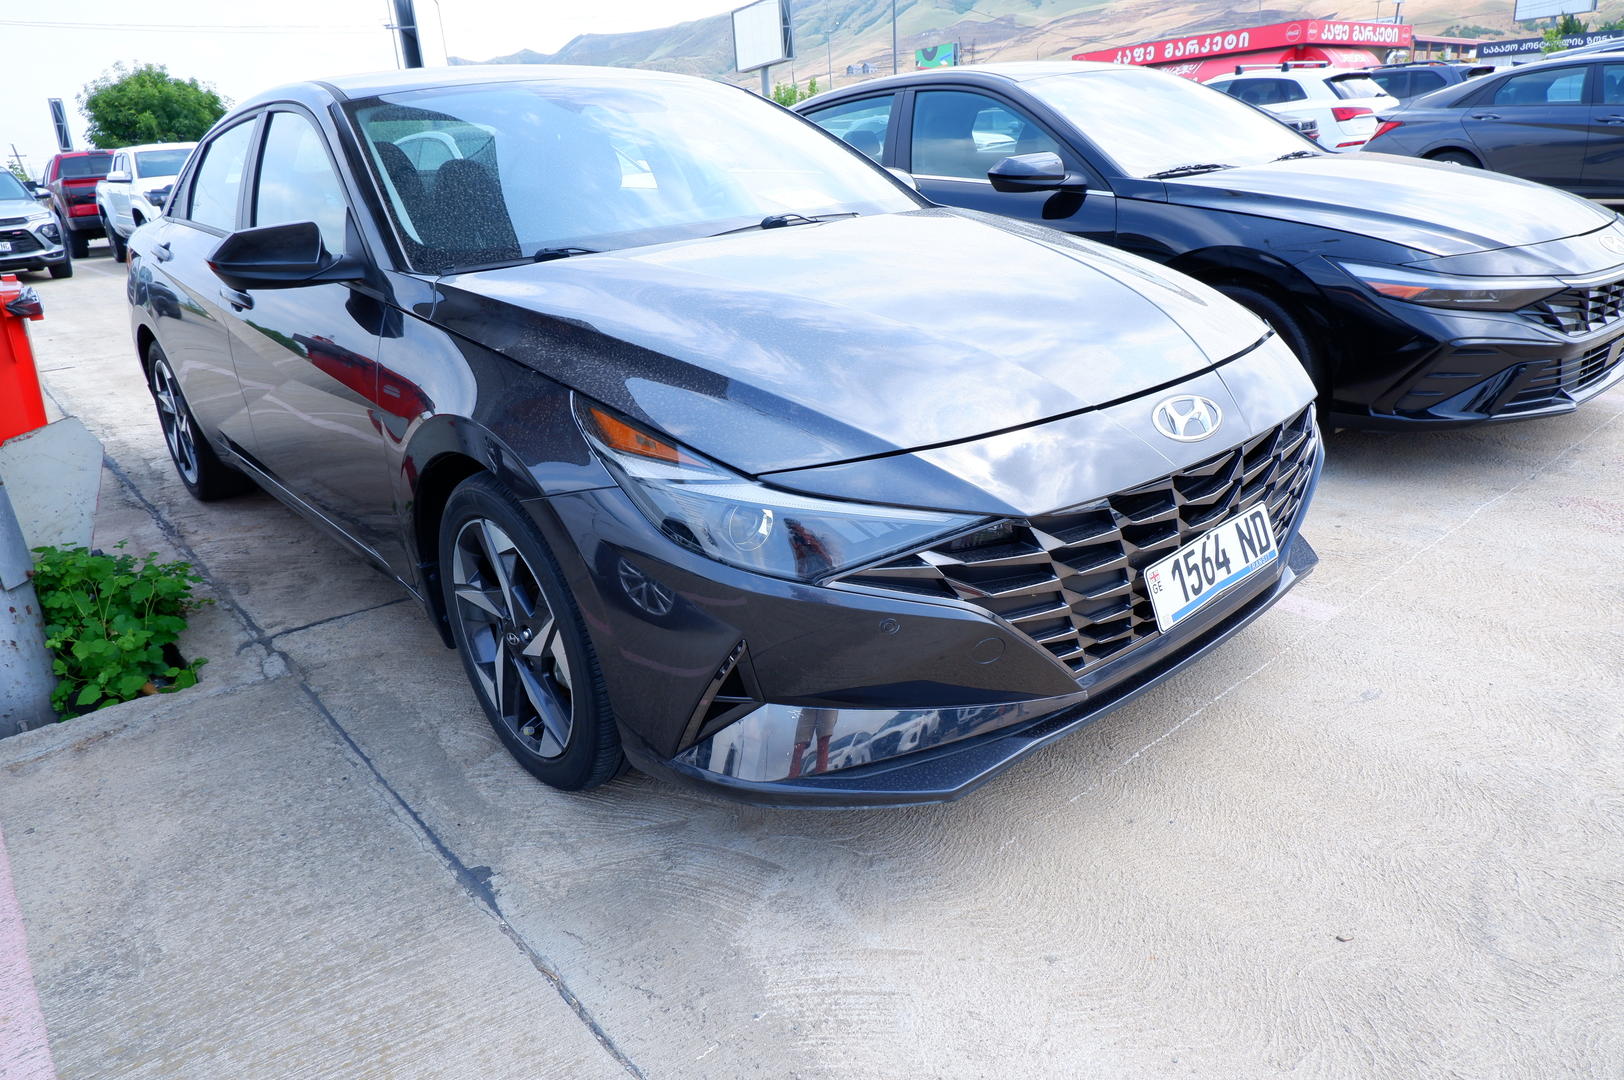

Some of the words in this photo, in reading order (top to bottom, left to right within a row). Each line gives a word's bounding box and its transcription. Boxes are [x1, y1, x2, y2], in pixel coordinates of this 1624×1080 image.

[1321, 24, 1350, 40] კაფე
[1353, 26, 1398, 43] მარკეტი
[1114, 46, 1155, 64] კაფე
[1164, 32, 1249, 58] მარკეტი
[1171, 534, 1232, 603] 1564
[1235, 511, 1271, 564] ND
[1152, 581, 1163, 594] GE
